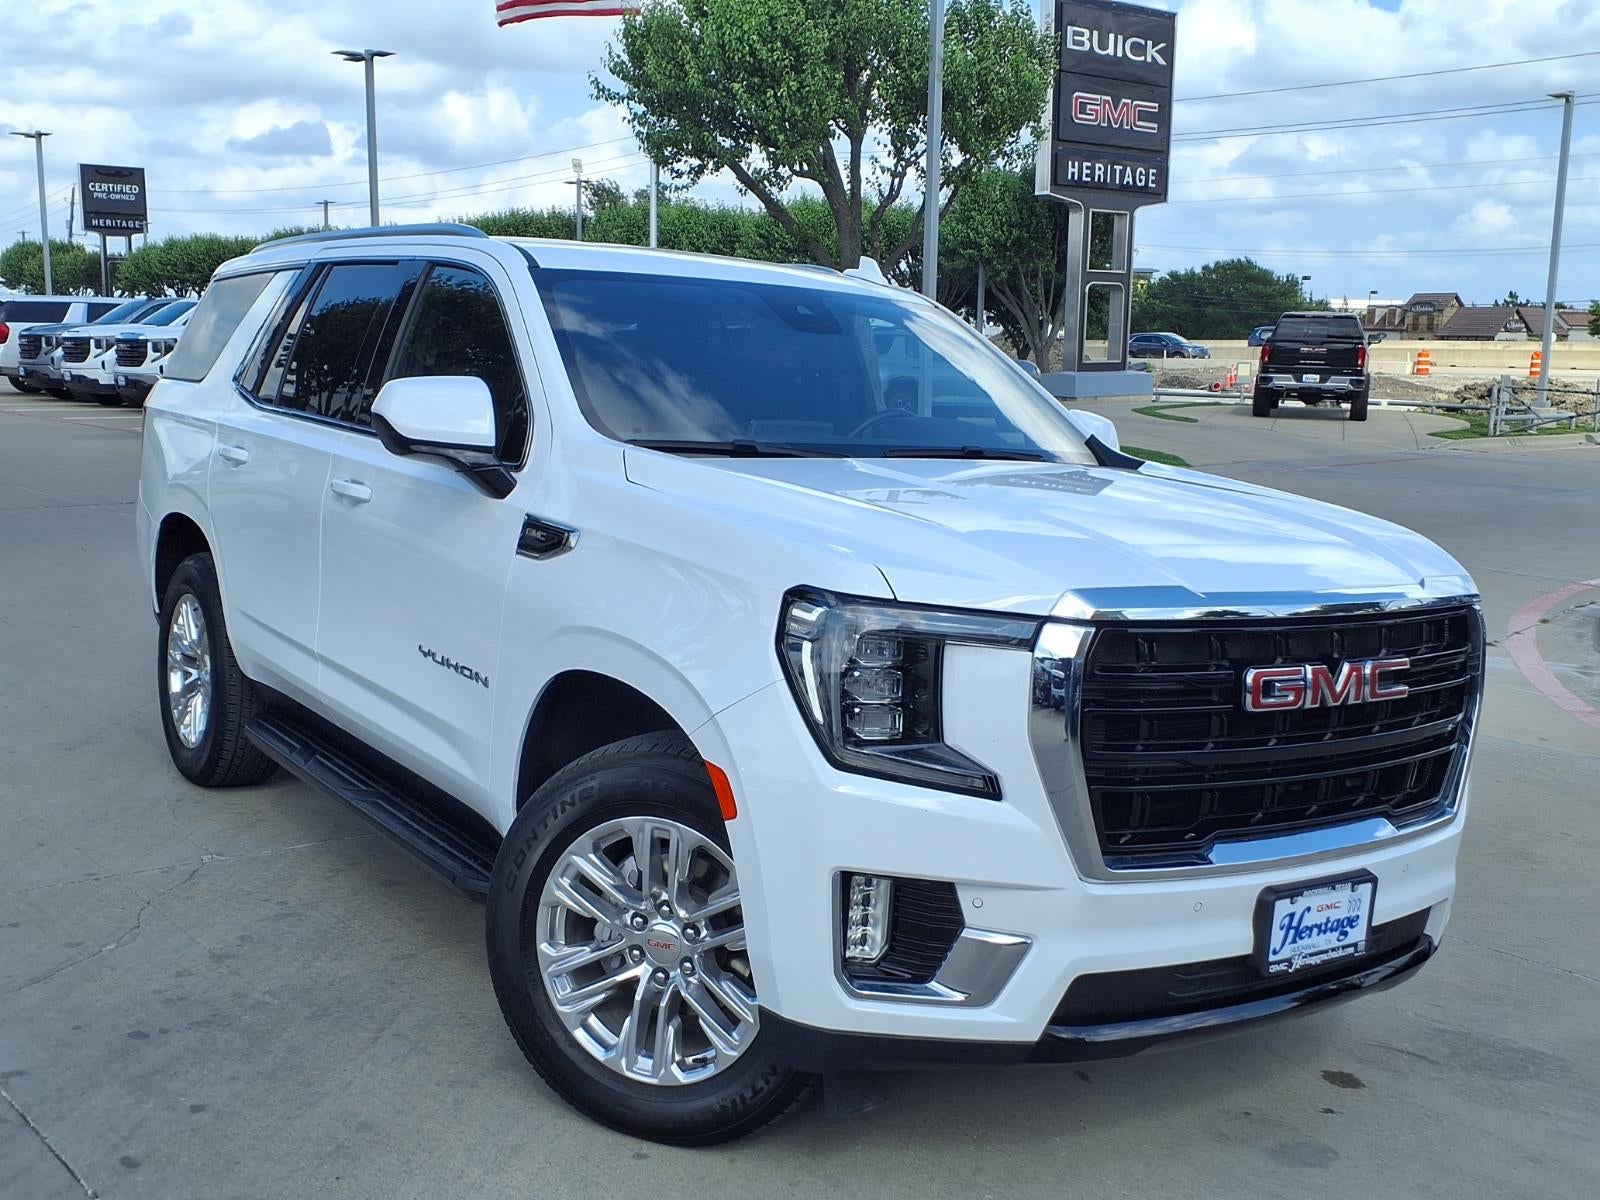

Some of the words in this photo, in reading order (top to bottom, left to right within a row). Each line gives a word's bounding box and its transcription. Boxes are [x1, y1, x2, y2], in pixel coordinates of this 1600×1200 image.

[1066, 25, 1167, 65] BUICK
[1072, 91, 1159, 133] GMC
[1067, 160, 1157, 188] HERITAGE
[88, 182, 139, 194] CERTIFIED
[93, 192, 136, 201] PRE-OWNED
[91, 218, 141, 228] HERITAGE
[418, 643, 489, 689] YUKON
[1244, 657, 1410, 712] GMC
[1316, 901, 1342, 912] GMC
[1271, 905, 1360, 956] Heritage
[647, 938, 678, 951] GMC
[1268, 962, 1289, 973] GMC
